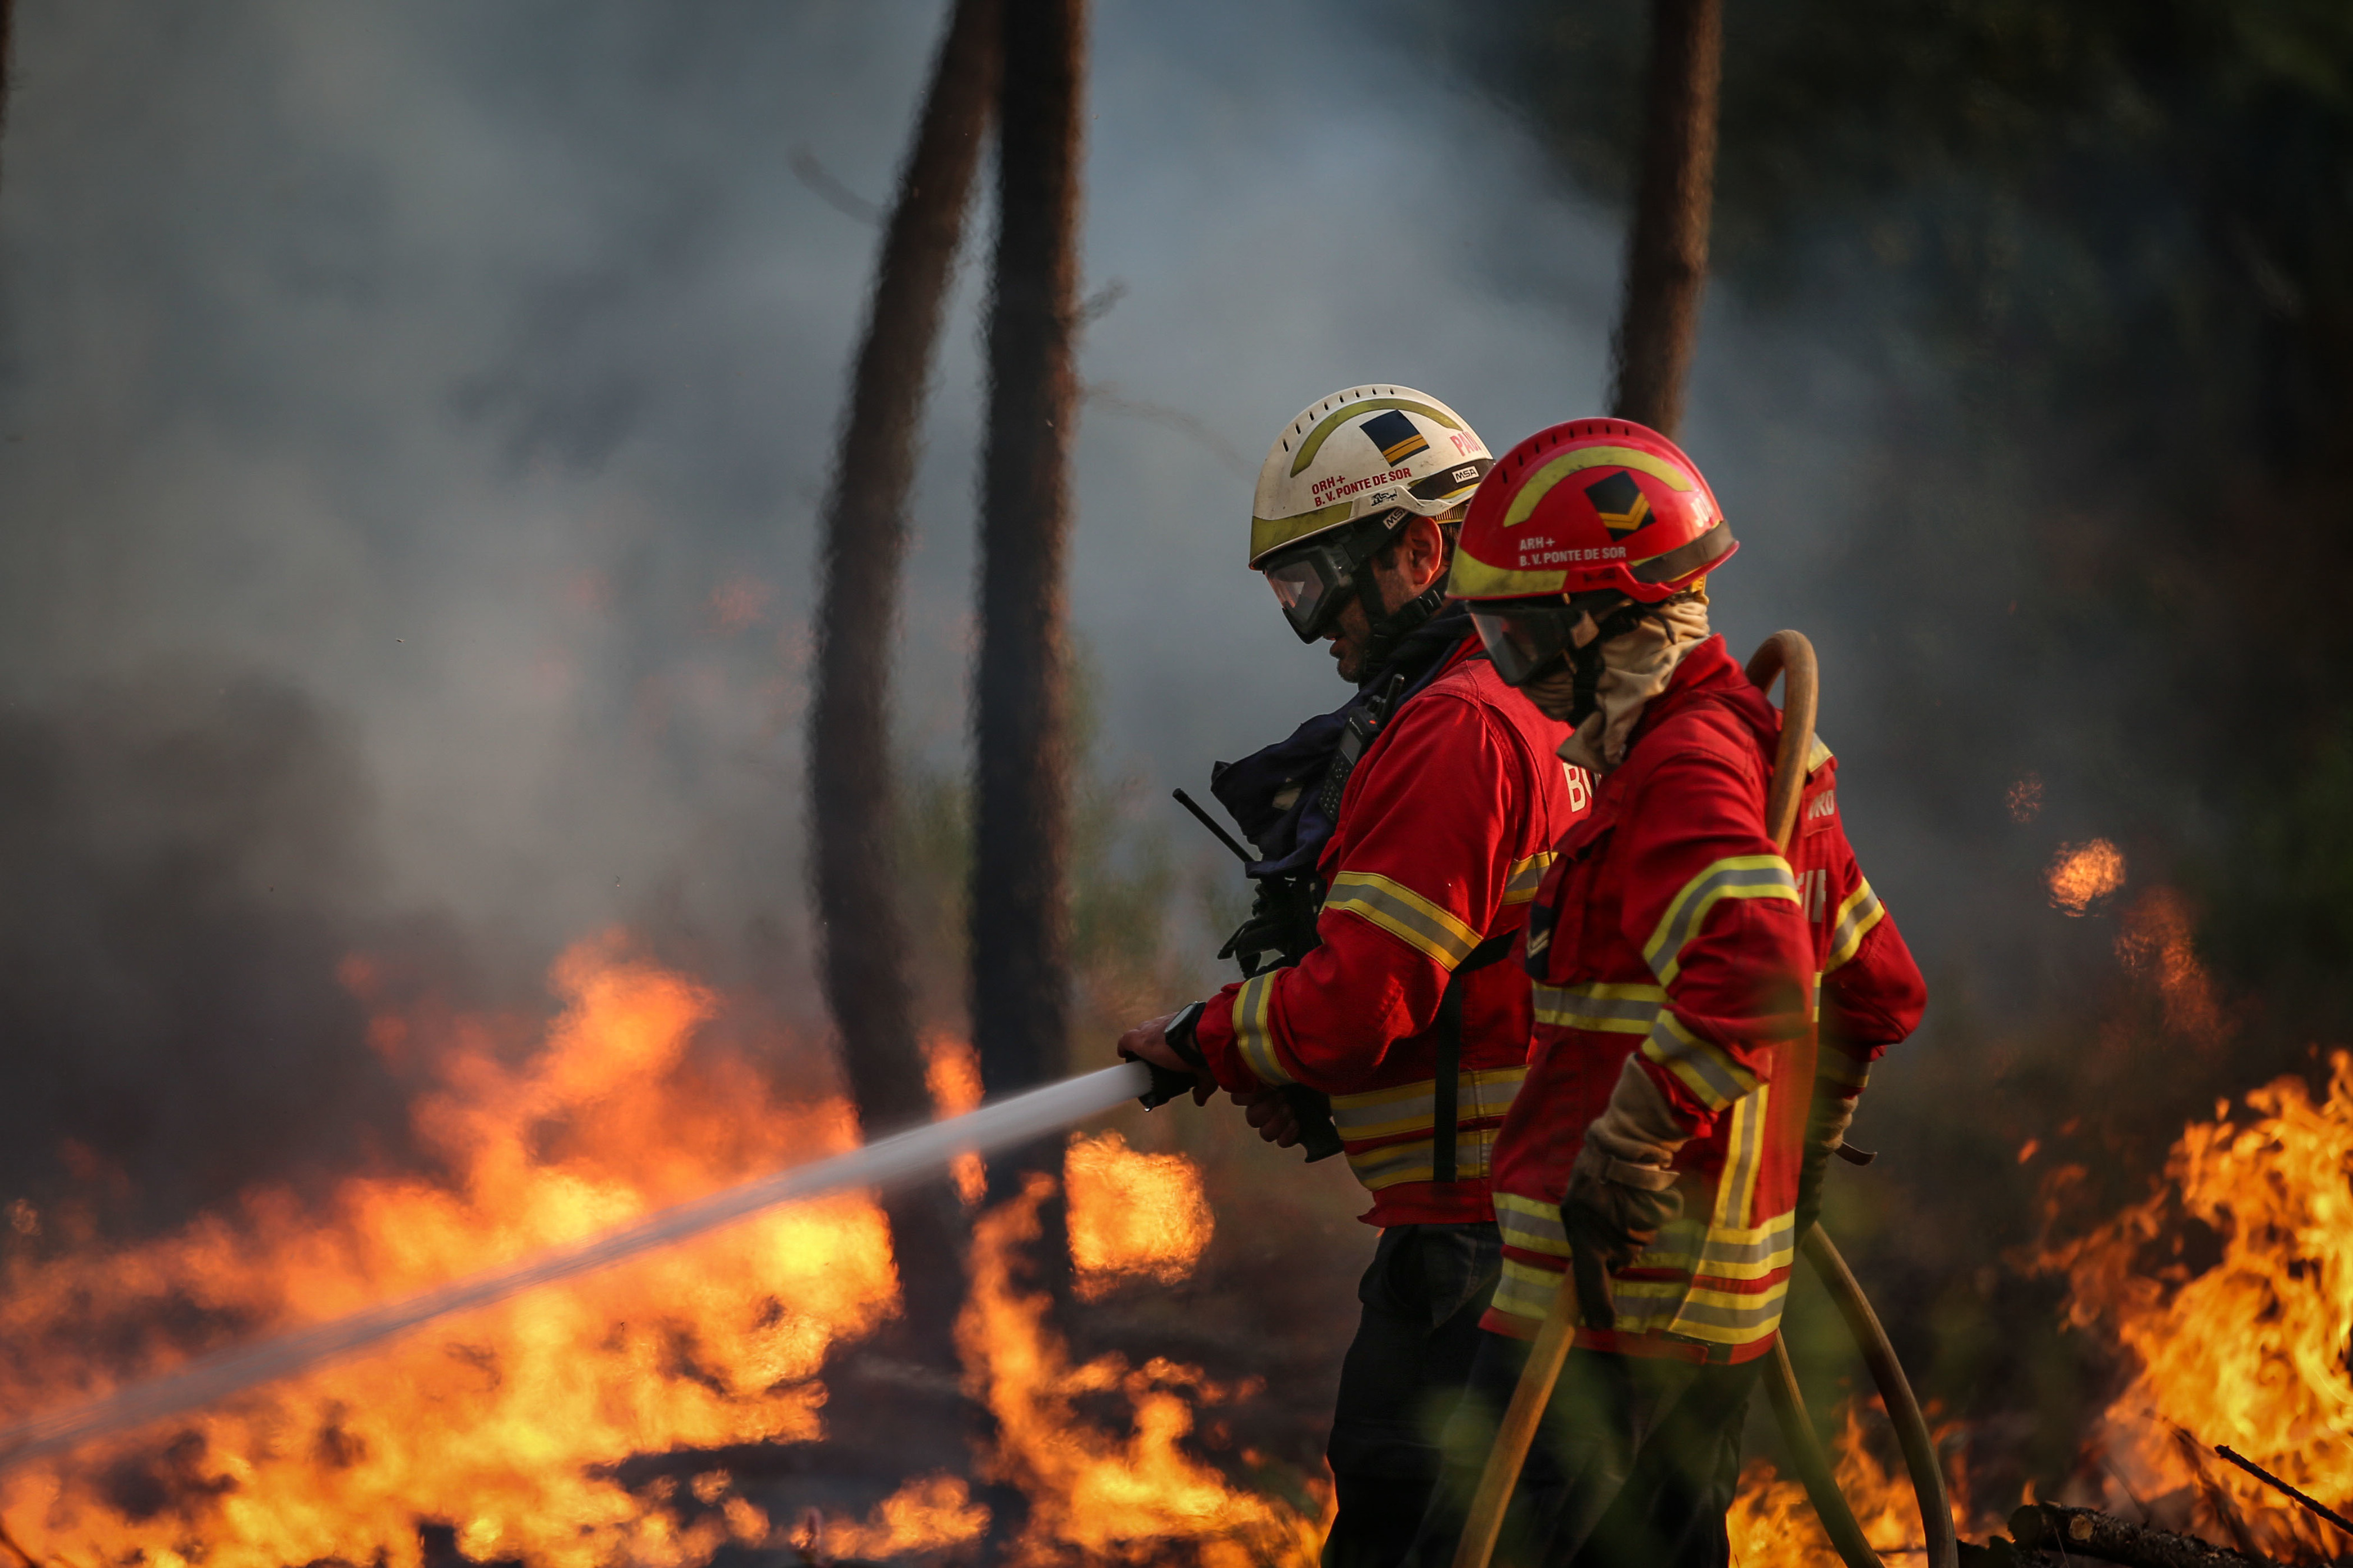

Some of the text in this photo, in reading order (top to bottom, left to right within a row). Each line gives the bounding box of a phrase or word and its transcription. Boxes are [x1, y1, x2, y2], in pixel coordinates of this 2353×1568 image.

[1336, 478, 1372, 498] PONTE
[1372, 473, 1388, 486] DE
[1388, 468, 1412, 482] SOR
[1455, 468, 1477, 481] MSA
[1543, 549, 1582, 563] PONTE
[1584, 548, 1600, 561] DE
[1602, 546, 1627, 559] SOR
